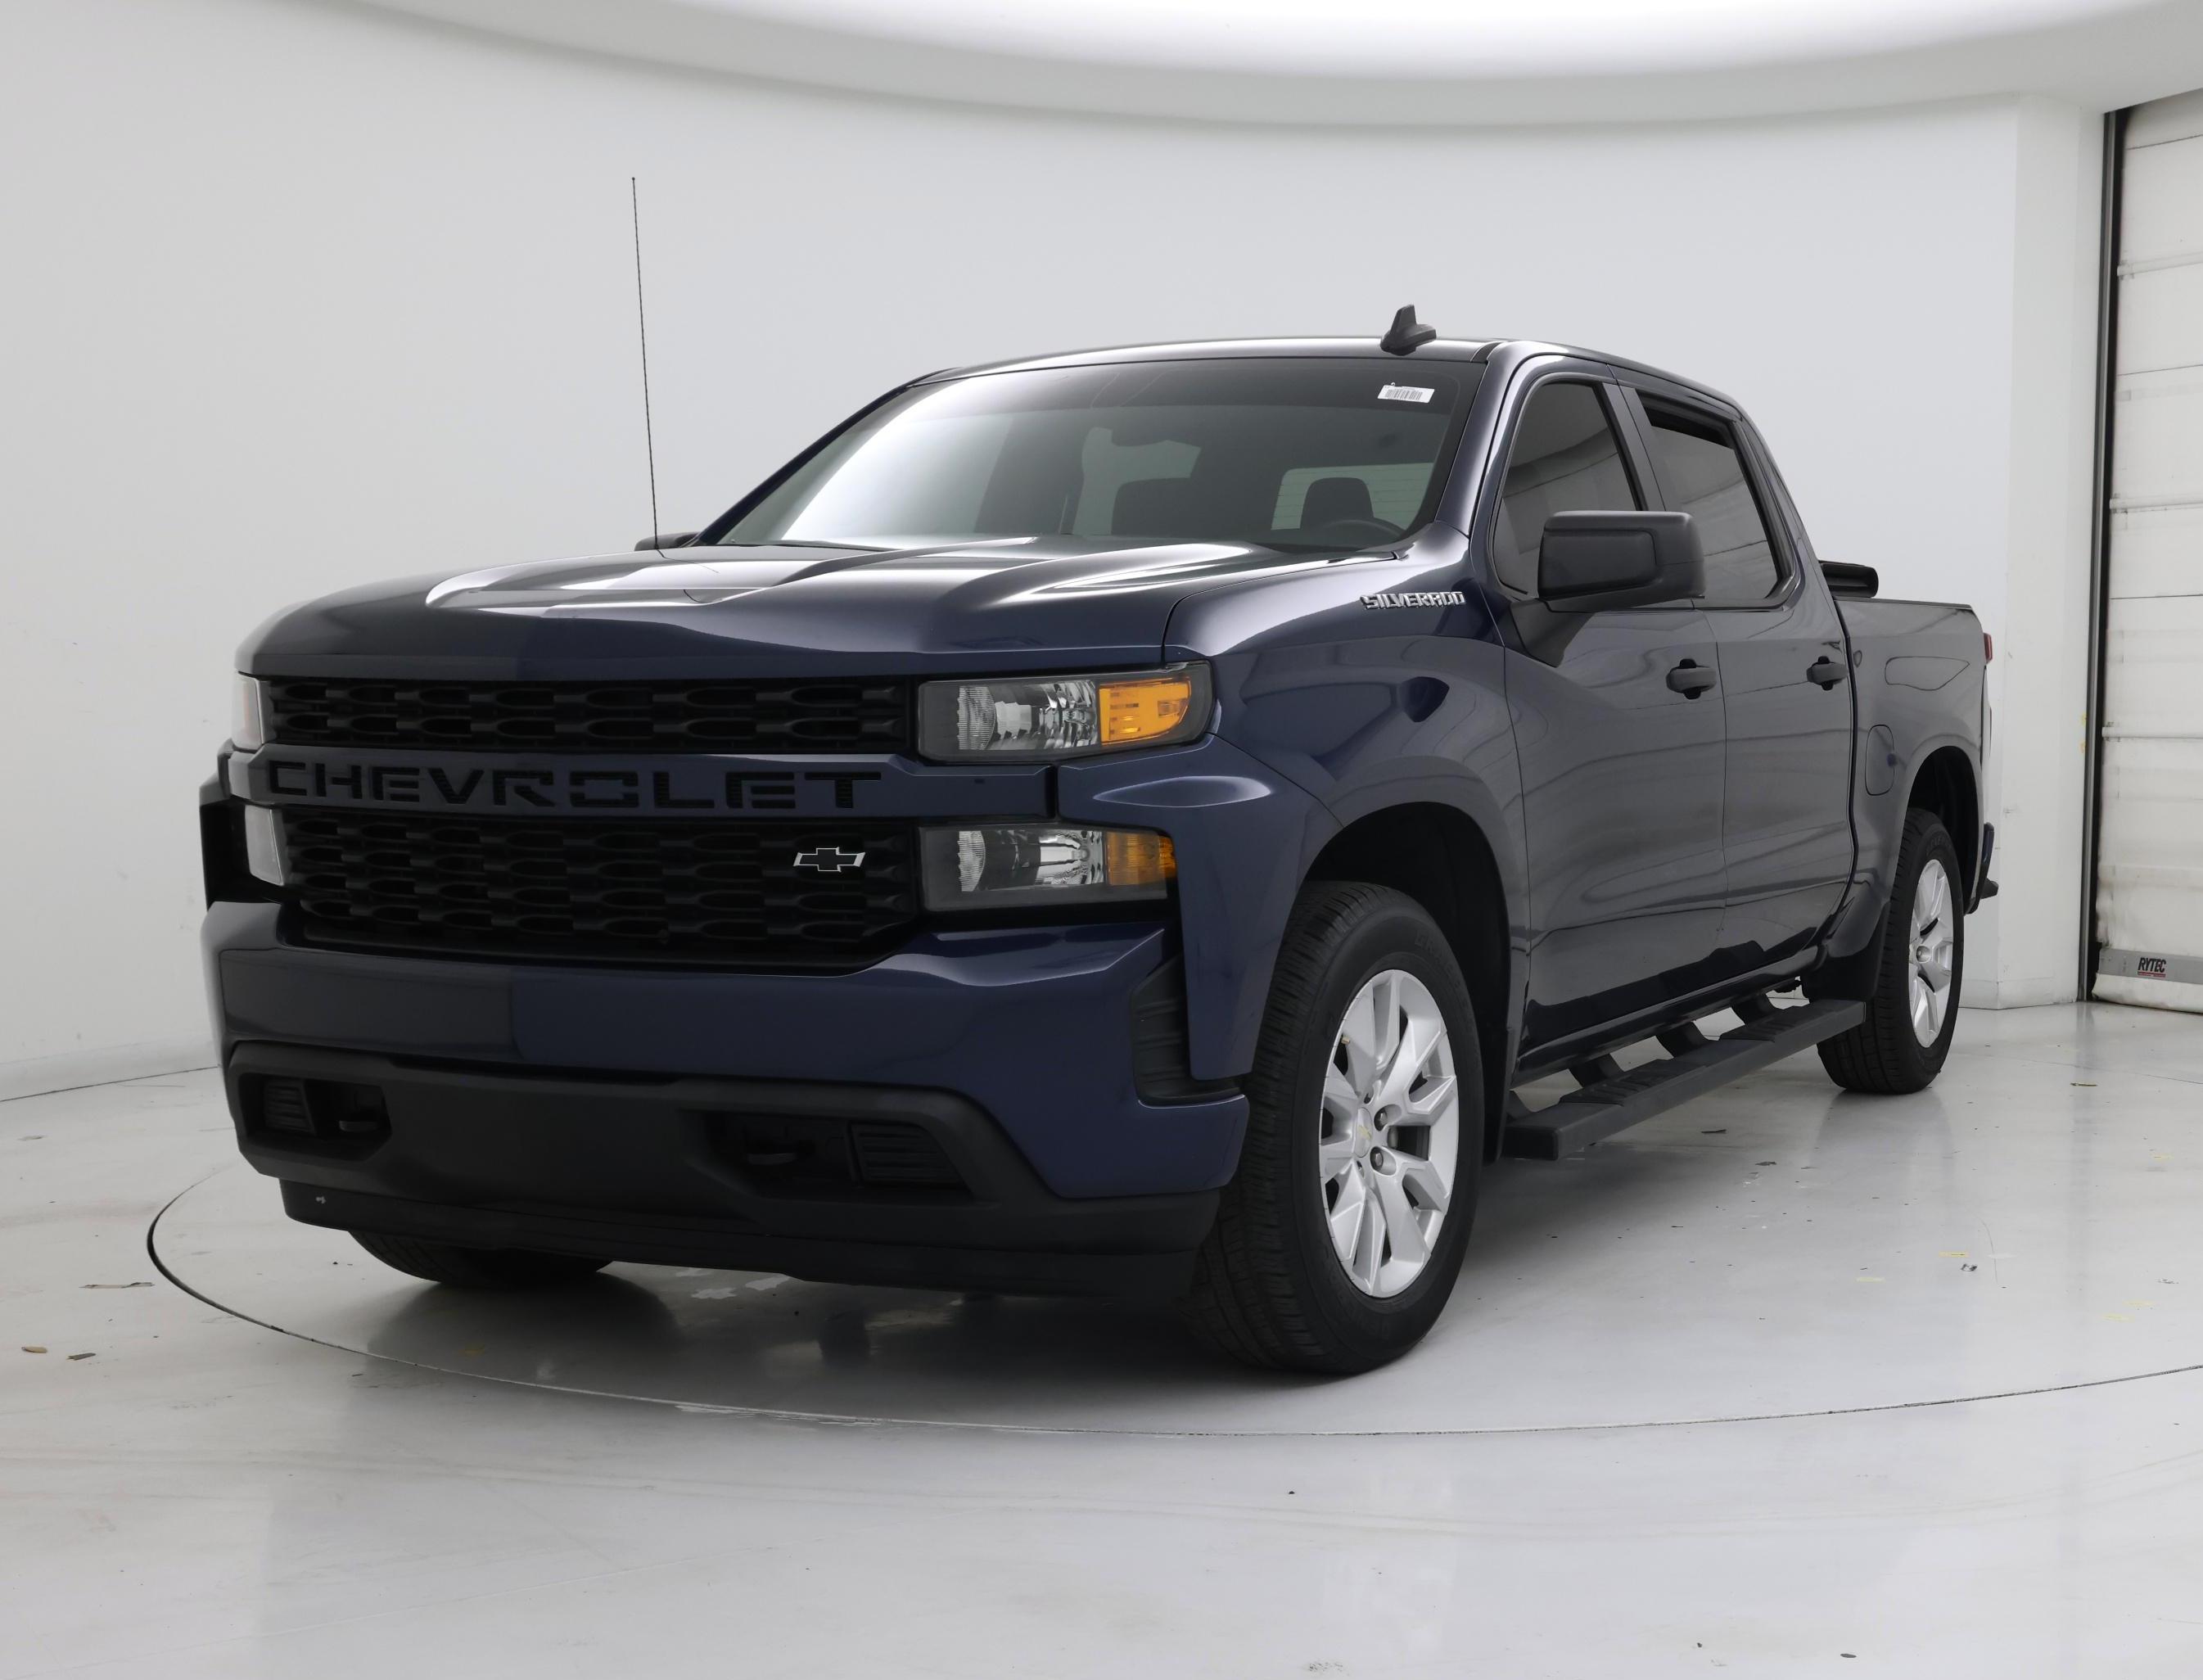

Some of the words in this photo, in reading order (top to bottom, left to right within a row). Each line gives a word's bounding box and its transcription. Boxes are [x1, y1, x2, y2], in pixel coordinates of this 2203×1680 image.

[1360, 591, 1466, 609] SILVERADO
[268, 760, 882, 809] CHEVROLET
[2138, 957, 2166, 973] RYTEC
